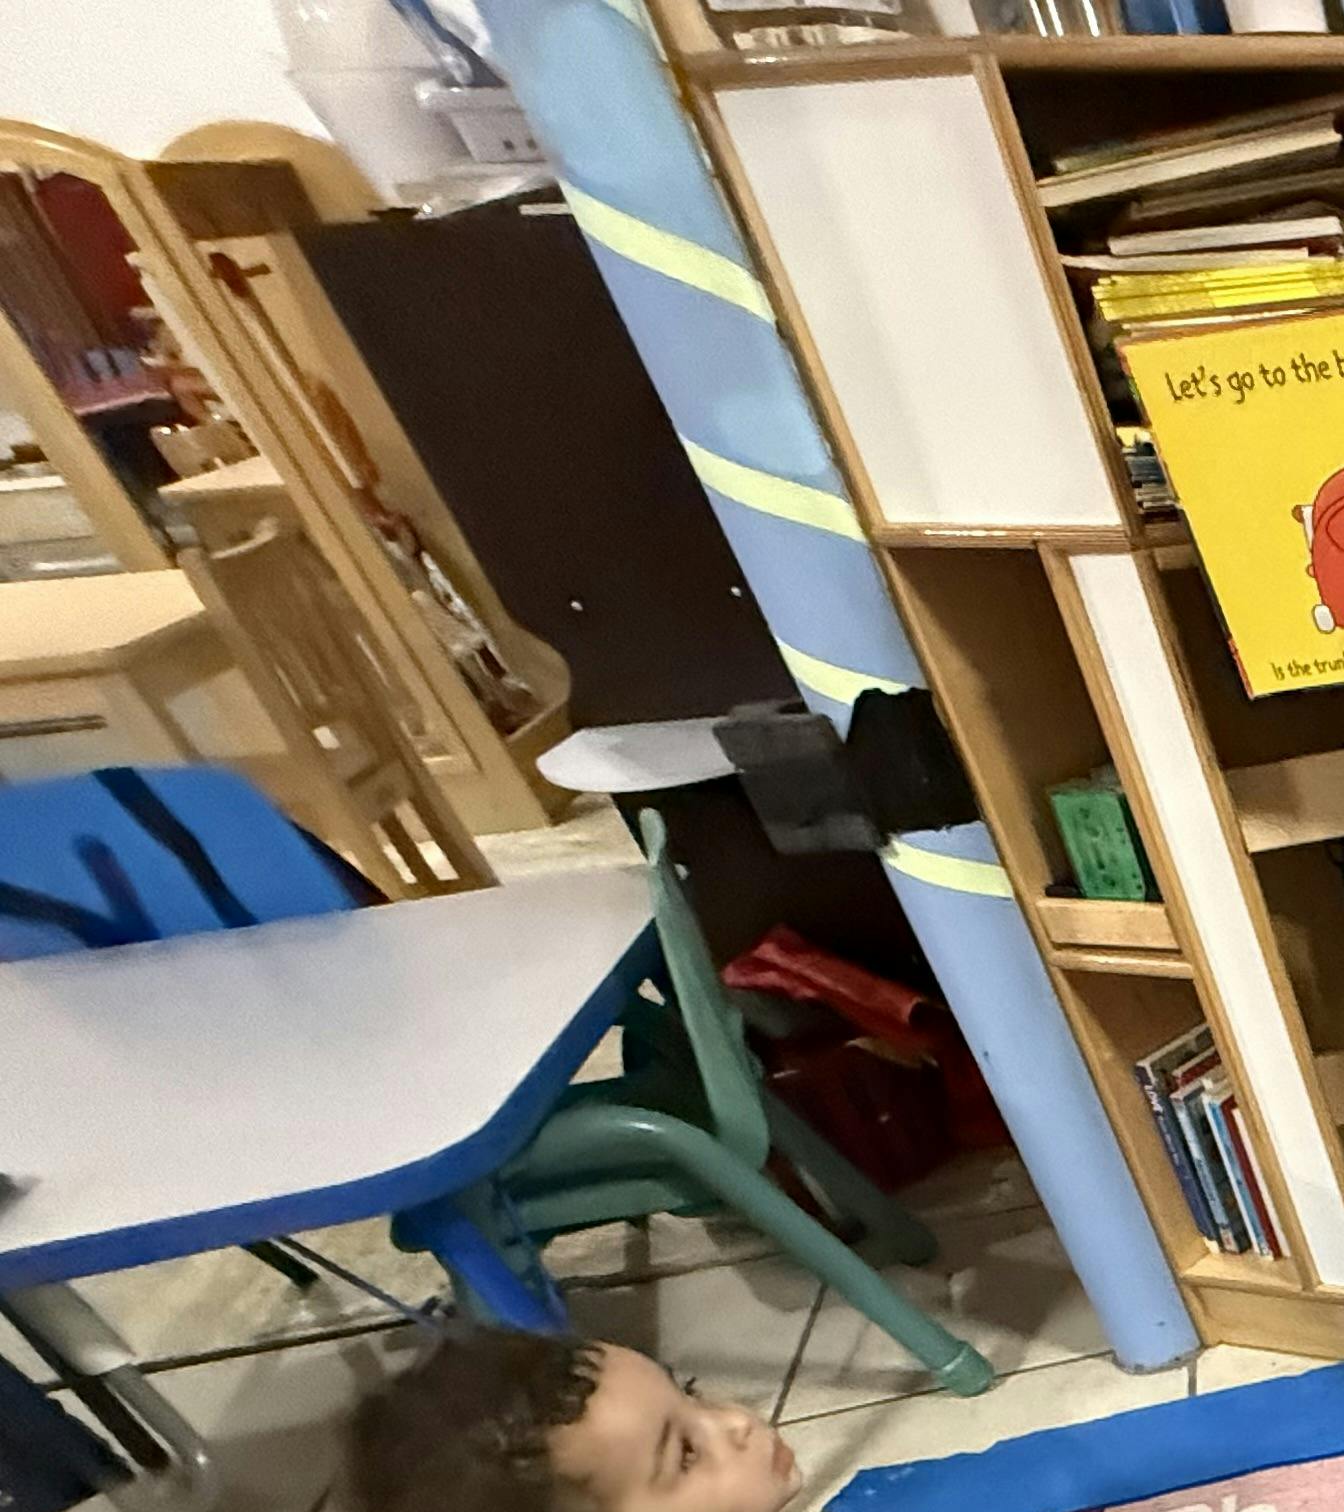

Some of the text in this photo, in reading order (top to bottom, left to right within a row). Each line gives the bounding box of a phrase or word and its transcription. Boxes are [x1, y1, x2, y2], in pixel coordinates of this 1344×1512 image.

[1165, 366, 1222, 402] Let's
[1227, 371, 1255, 404] go
[1259, 364, 1286, 387] to
[1291, 353, 1332, 383] the
[1270, 662, 1285, 681] Is
[1287, 659, 1312, 678] the
